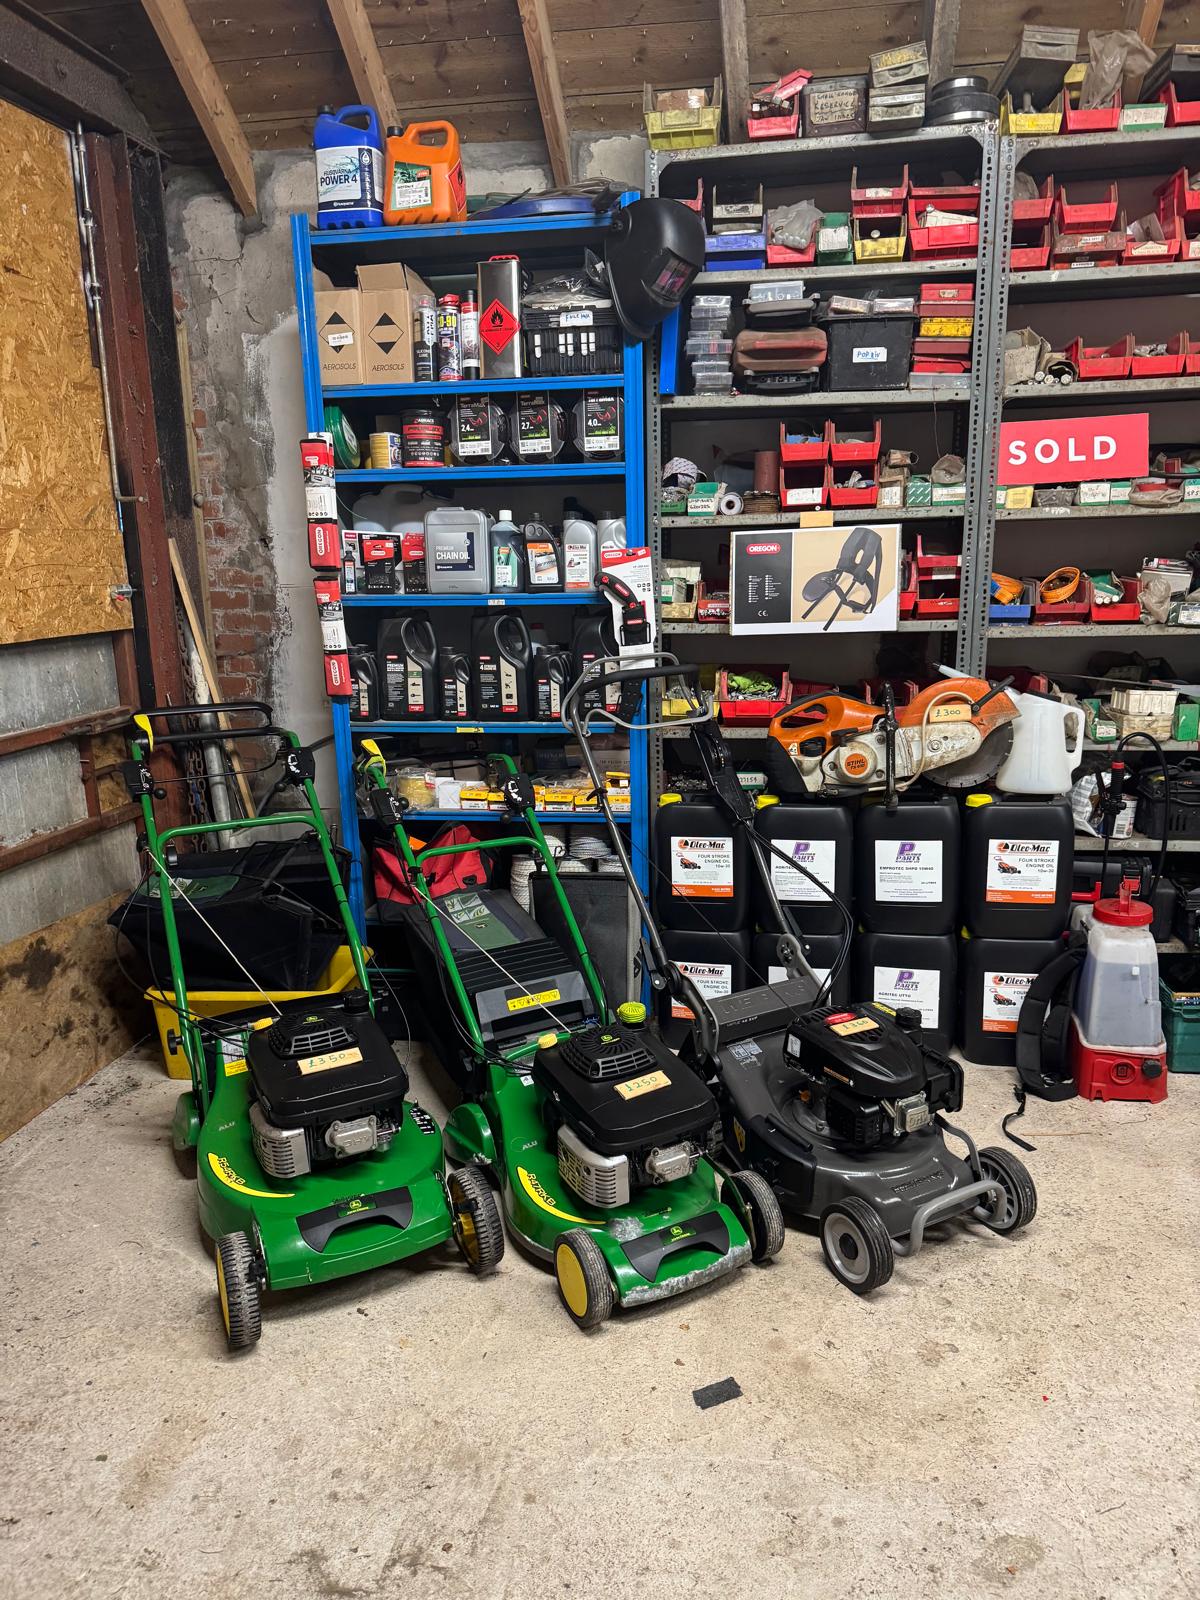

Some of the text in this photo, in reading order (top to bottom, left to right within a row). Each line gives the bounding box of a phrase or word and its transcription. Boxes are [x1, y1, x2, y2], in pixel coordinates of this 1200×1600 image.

[320, 174, 358, 187] POWER 4
[322, 362, 357, 371] AEROSOLS
[371, 363, 405, 372] AEROSOLS
[1008, 435, 1117, 466] SOLD
[748, 544, 778, 553] OREGON
[436, 551, 470, 560] CHAIN OIL
[522, 1140, 538, 1150] ALU
